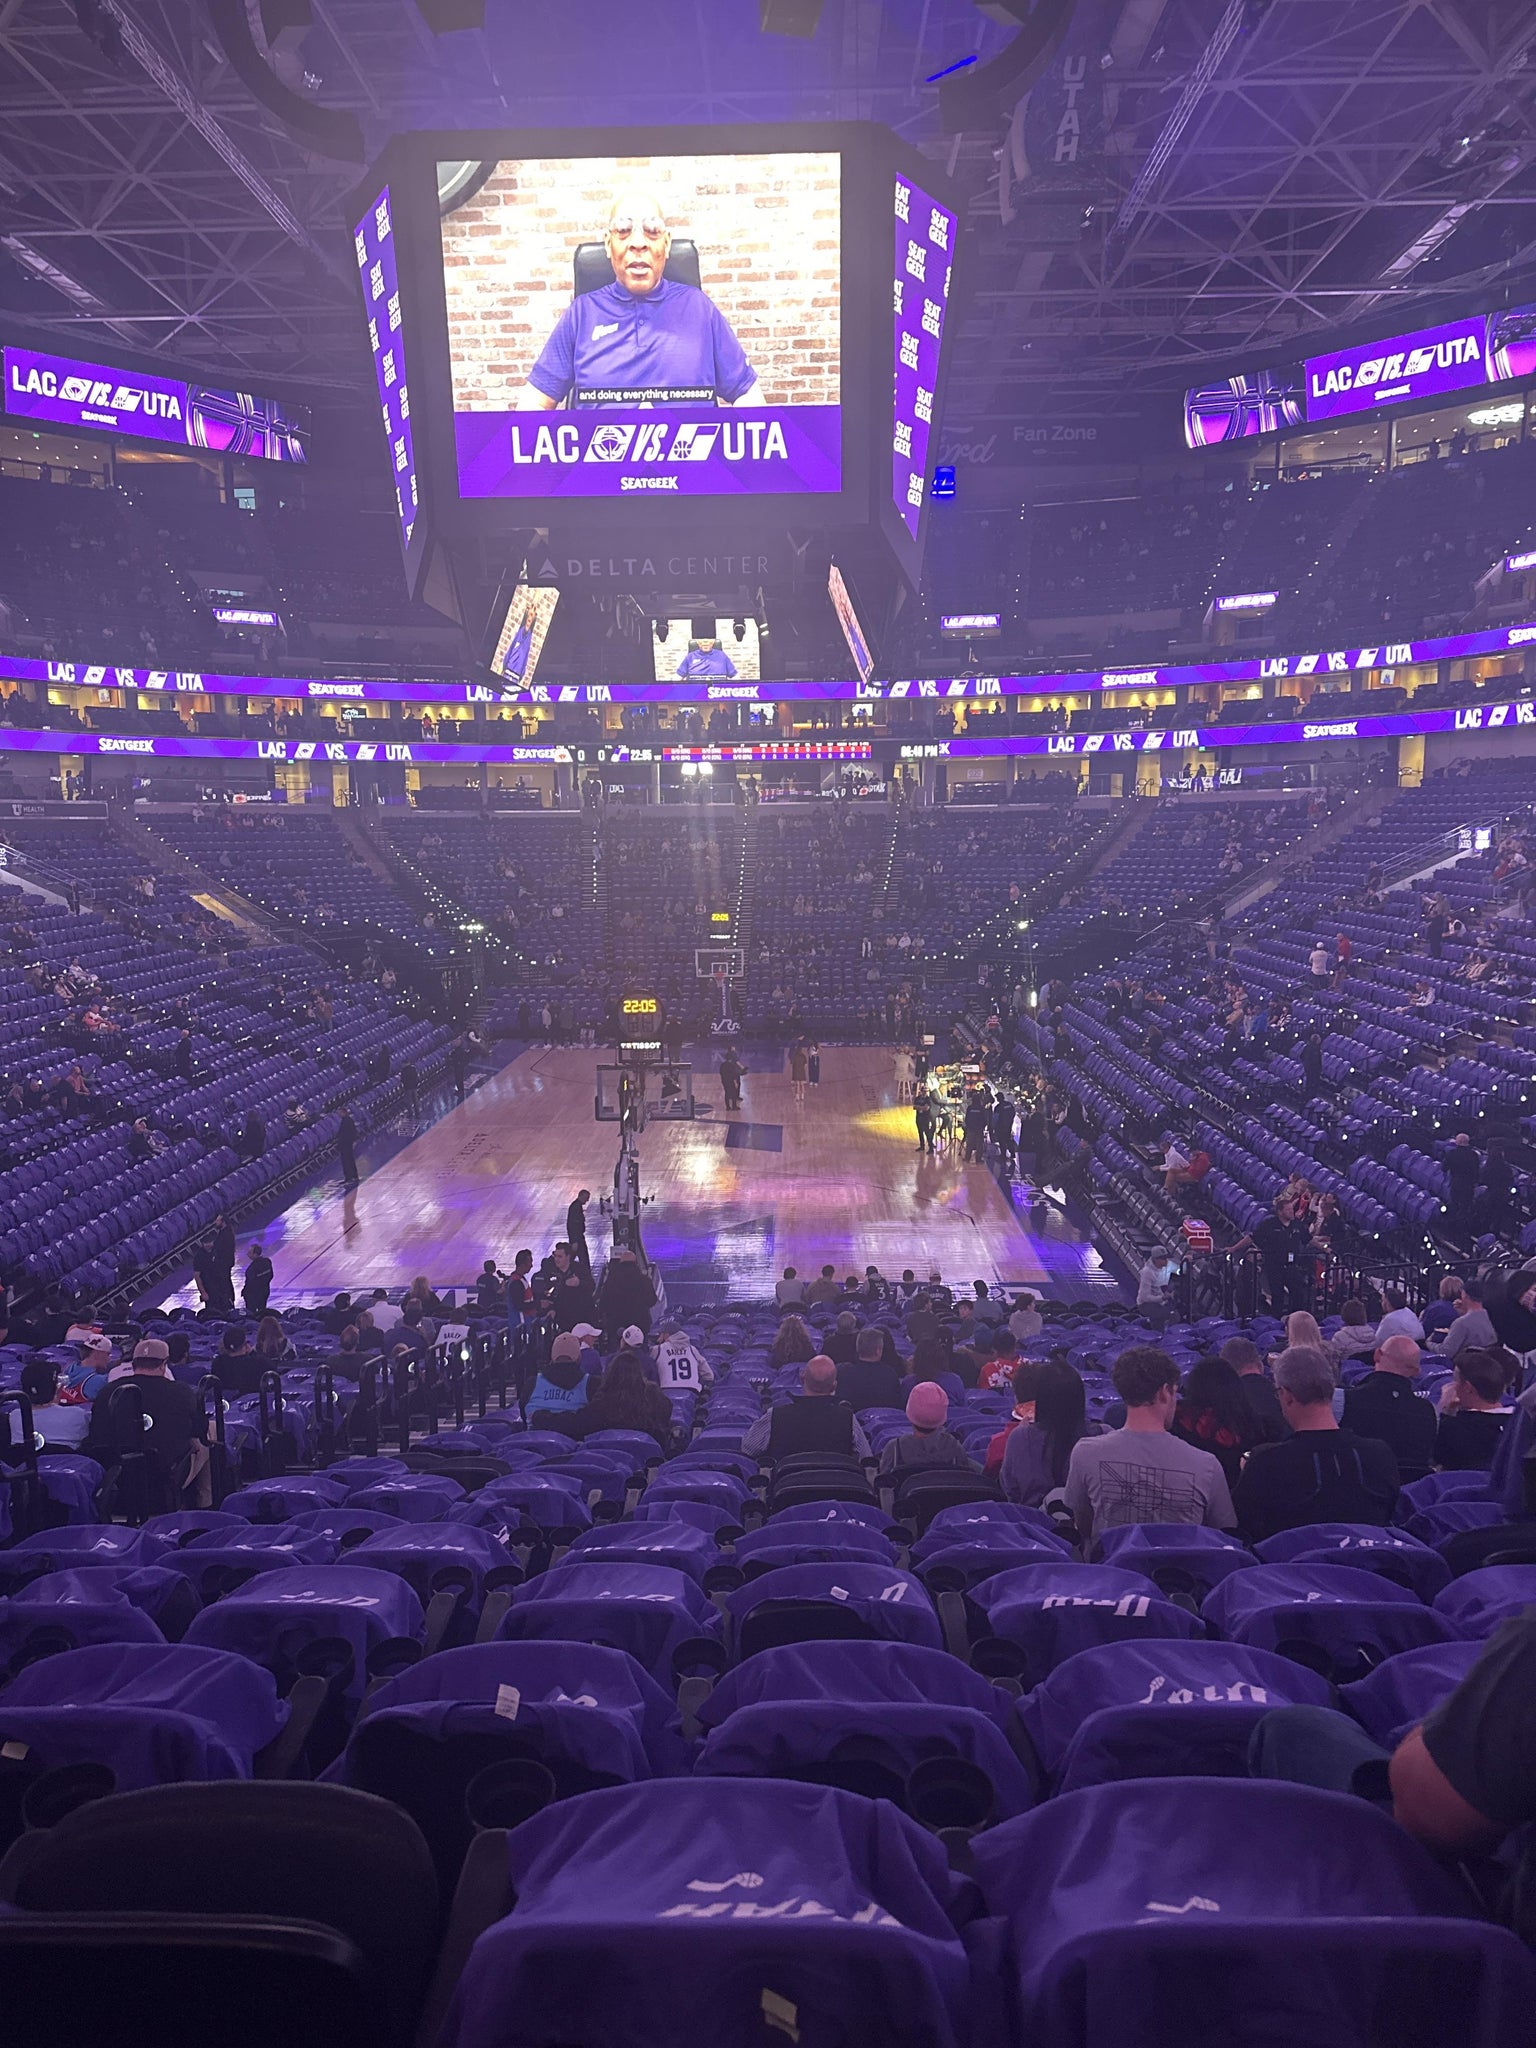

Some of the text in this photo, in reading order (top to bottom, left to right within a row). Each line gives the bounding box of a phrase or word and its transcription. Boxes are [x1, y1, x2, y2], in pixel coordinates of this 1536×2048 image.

[1055, 56, 1087, 162] UTAH
[930, 208, 949, 233] SEAT
[928, 225, 948, 251] GEEK
[907, 240, 927, 264] SEAT
[905, 256, 926, 283] GEEK
[924, 298, 942, 321] SEAT
[921, 314, 940, 339] GEEK
[901, 331, 920, 354] SEAT
[899, 347, 919, 371] GEEK
[1312, 365, 1352, 398] LAC
[1436, 336, 1480, 367] UTA
[13, 366, 181, 419] LAC VS. UTA
[580, 389, 713, 401] and doing everything necessary
[917, 387, 933, 408] SEAT
[914, 403, 932, 425] GEEK
[896, 421, 912, 440] SEAT
[1013, 426, 1097, 441] Fan Zone
[512, 422, 787, 463] LAC VS. UTA
[893, 437, 911, 459] GEEK
[621, 477, 678, 490] SEATGEEK
[568, 556, 769, 577] DELTA CENTER
[1261, 644, 1412, 676] LAC VS. UTA
[48, 662, 203, 691] LAC VS. UTA
[919, 680, 939, 696] VS.
[976, 678, 1001, 695] UTA
[1102, 671, 1156, 687] SEATGEEK
[309, 683, 364, 696] SEATGEEK
[529, 684, 551, 702] VS.
[587, 686, 611, 701] UTA
[708, 686, 759, 698] SEATGEEK
[1456, 703, 1536, 728] LAC VS.
[1304, 722, 1357, 738] SEATGEEK
[99, 738, 154, 752] SEATGEEK
[258, 742, 412, 760] LAC VS. UTA
[1048, 730, 1198, 752] LAC VS. UTA
[578, 750, 585, 761] 0
[598, 750, 605, 761] 0
[623, 999, 657, 1013] 22:05
[631, 1041, 662, 1050] TISSOT
[877, 1286, 886, 1300] 3
[668, 1357, 692, 1381] 19
[543, 1389, 574, 1402] ZUBAC
